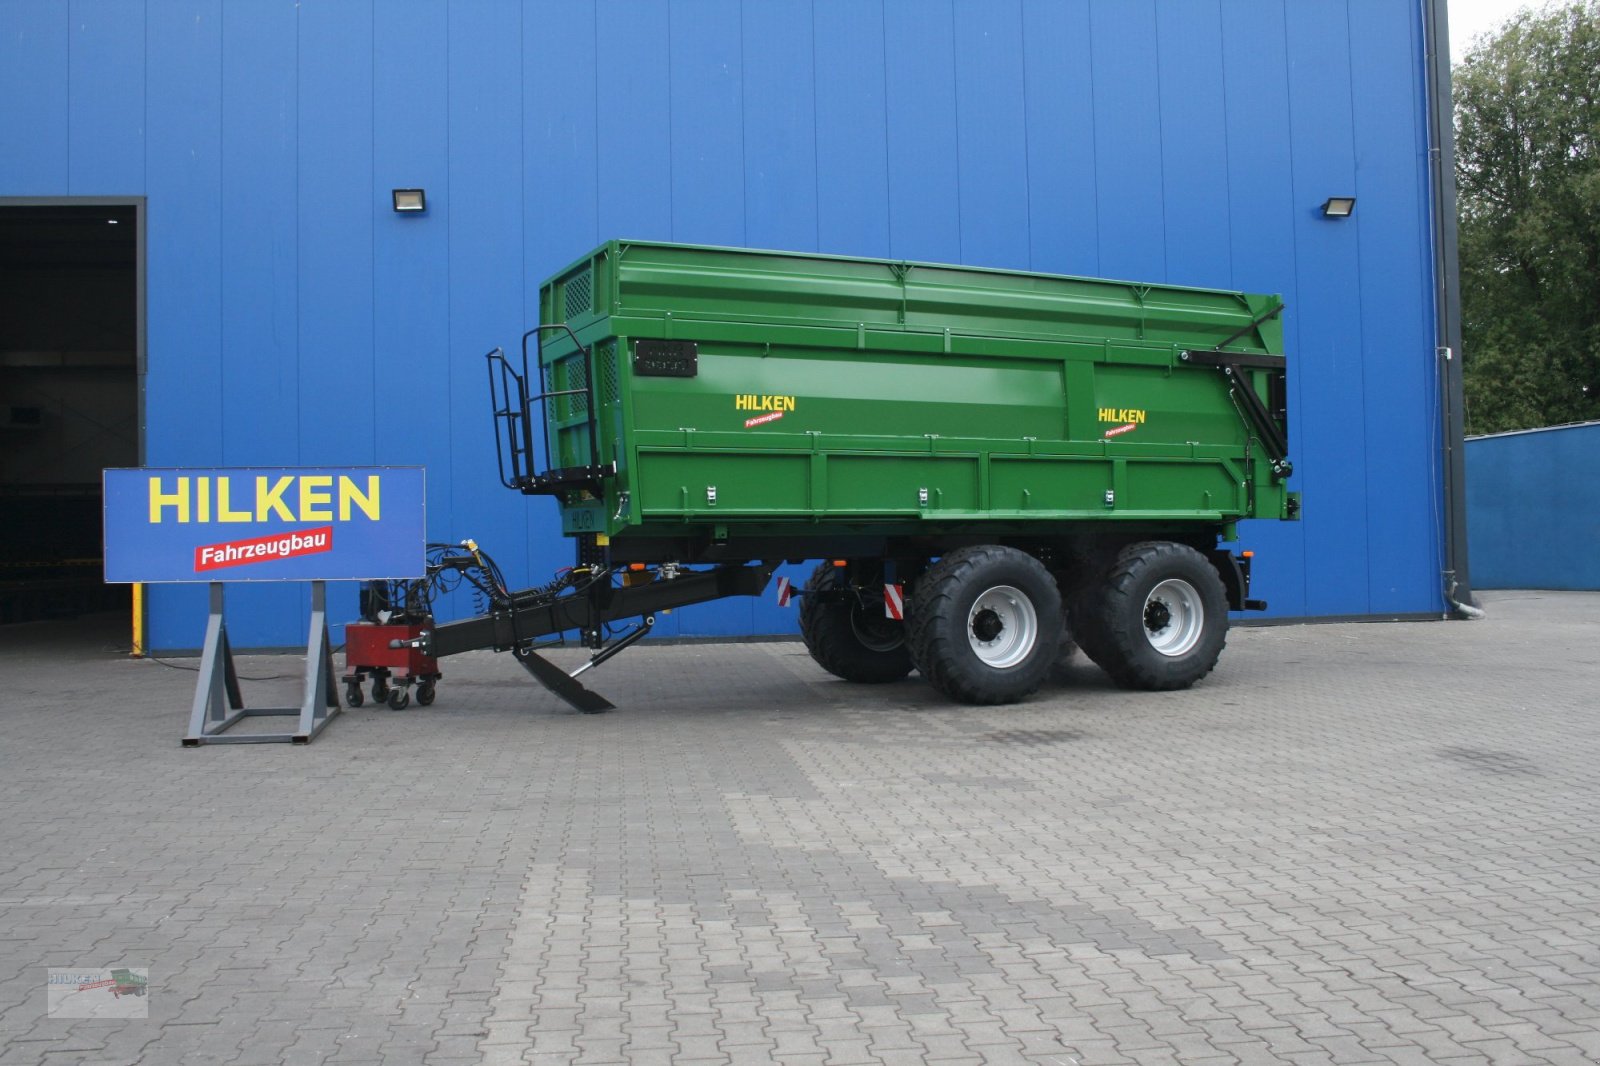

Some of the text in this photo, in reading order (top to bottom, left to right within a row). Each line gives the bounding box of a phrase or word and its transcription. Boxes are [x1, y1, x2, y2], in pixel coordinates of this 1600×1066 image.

[736, 395, 795, 411] HILKEN
[745, 412, 783, 426] Fahrzeugbau
[1098, 408, 1145, 423] HILKEN
[149, 475, 380, 524] HILKEN
[201, 532, 326, 565] Fahrzeugbau
